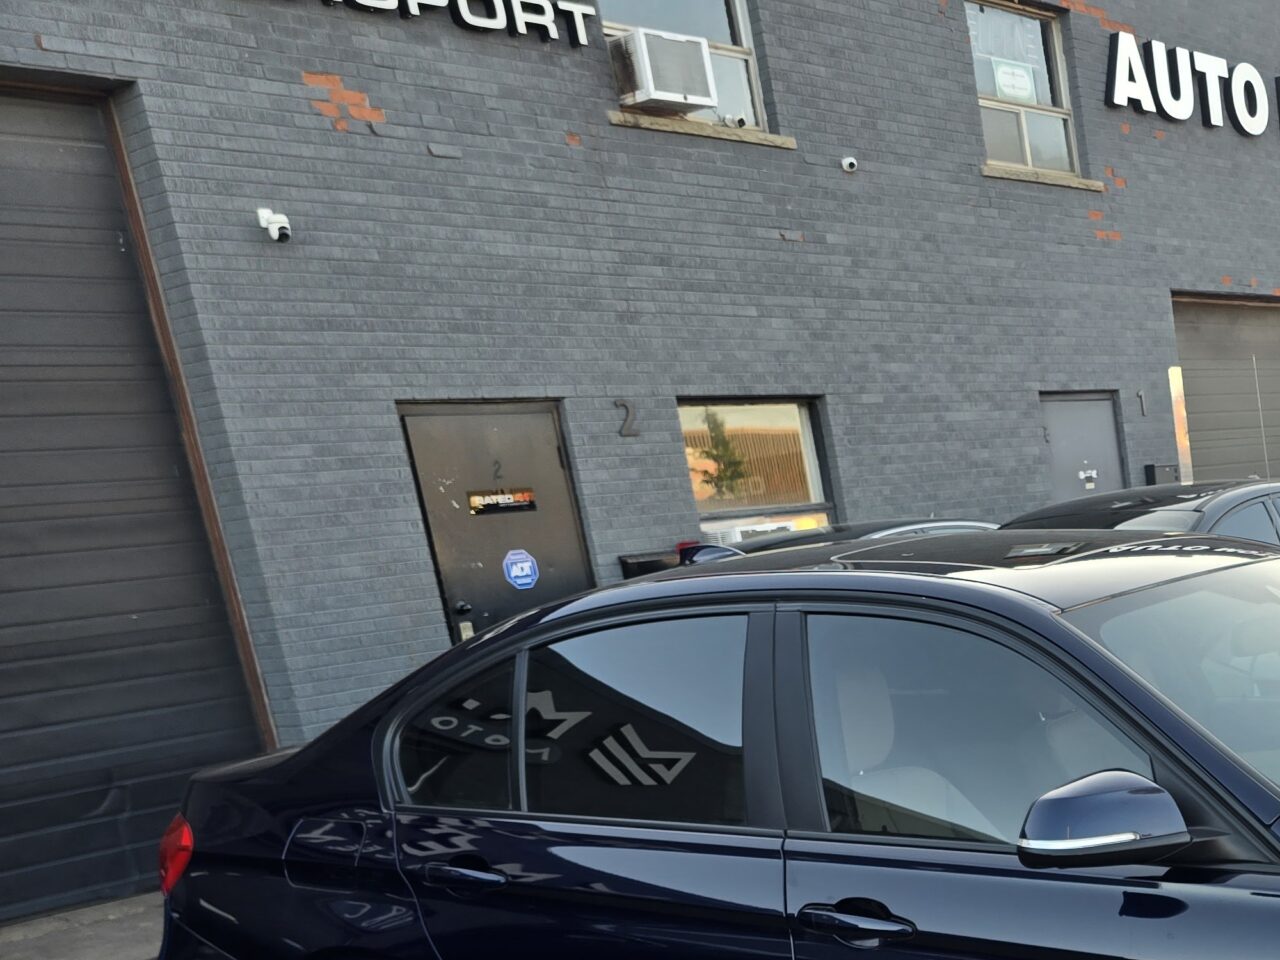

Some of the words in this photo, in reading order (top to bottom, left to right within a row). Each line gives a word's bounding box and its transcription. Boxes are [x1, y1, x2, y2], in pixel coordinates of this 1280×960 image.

[1109, 31, 1269, 136] AUTO
[613, 399, 640, 437] 2
[492, 460, 503, 480] 2
[510, 561, 532, 578] ADT
